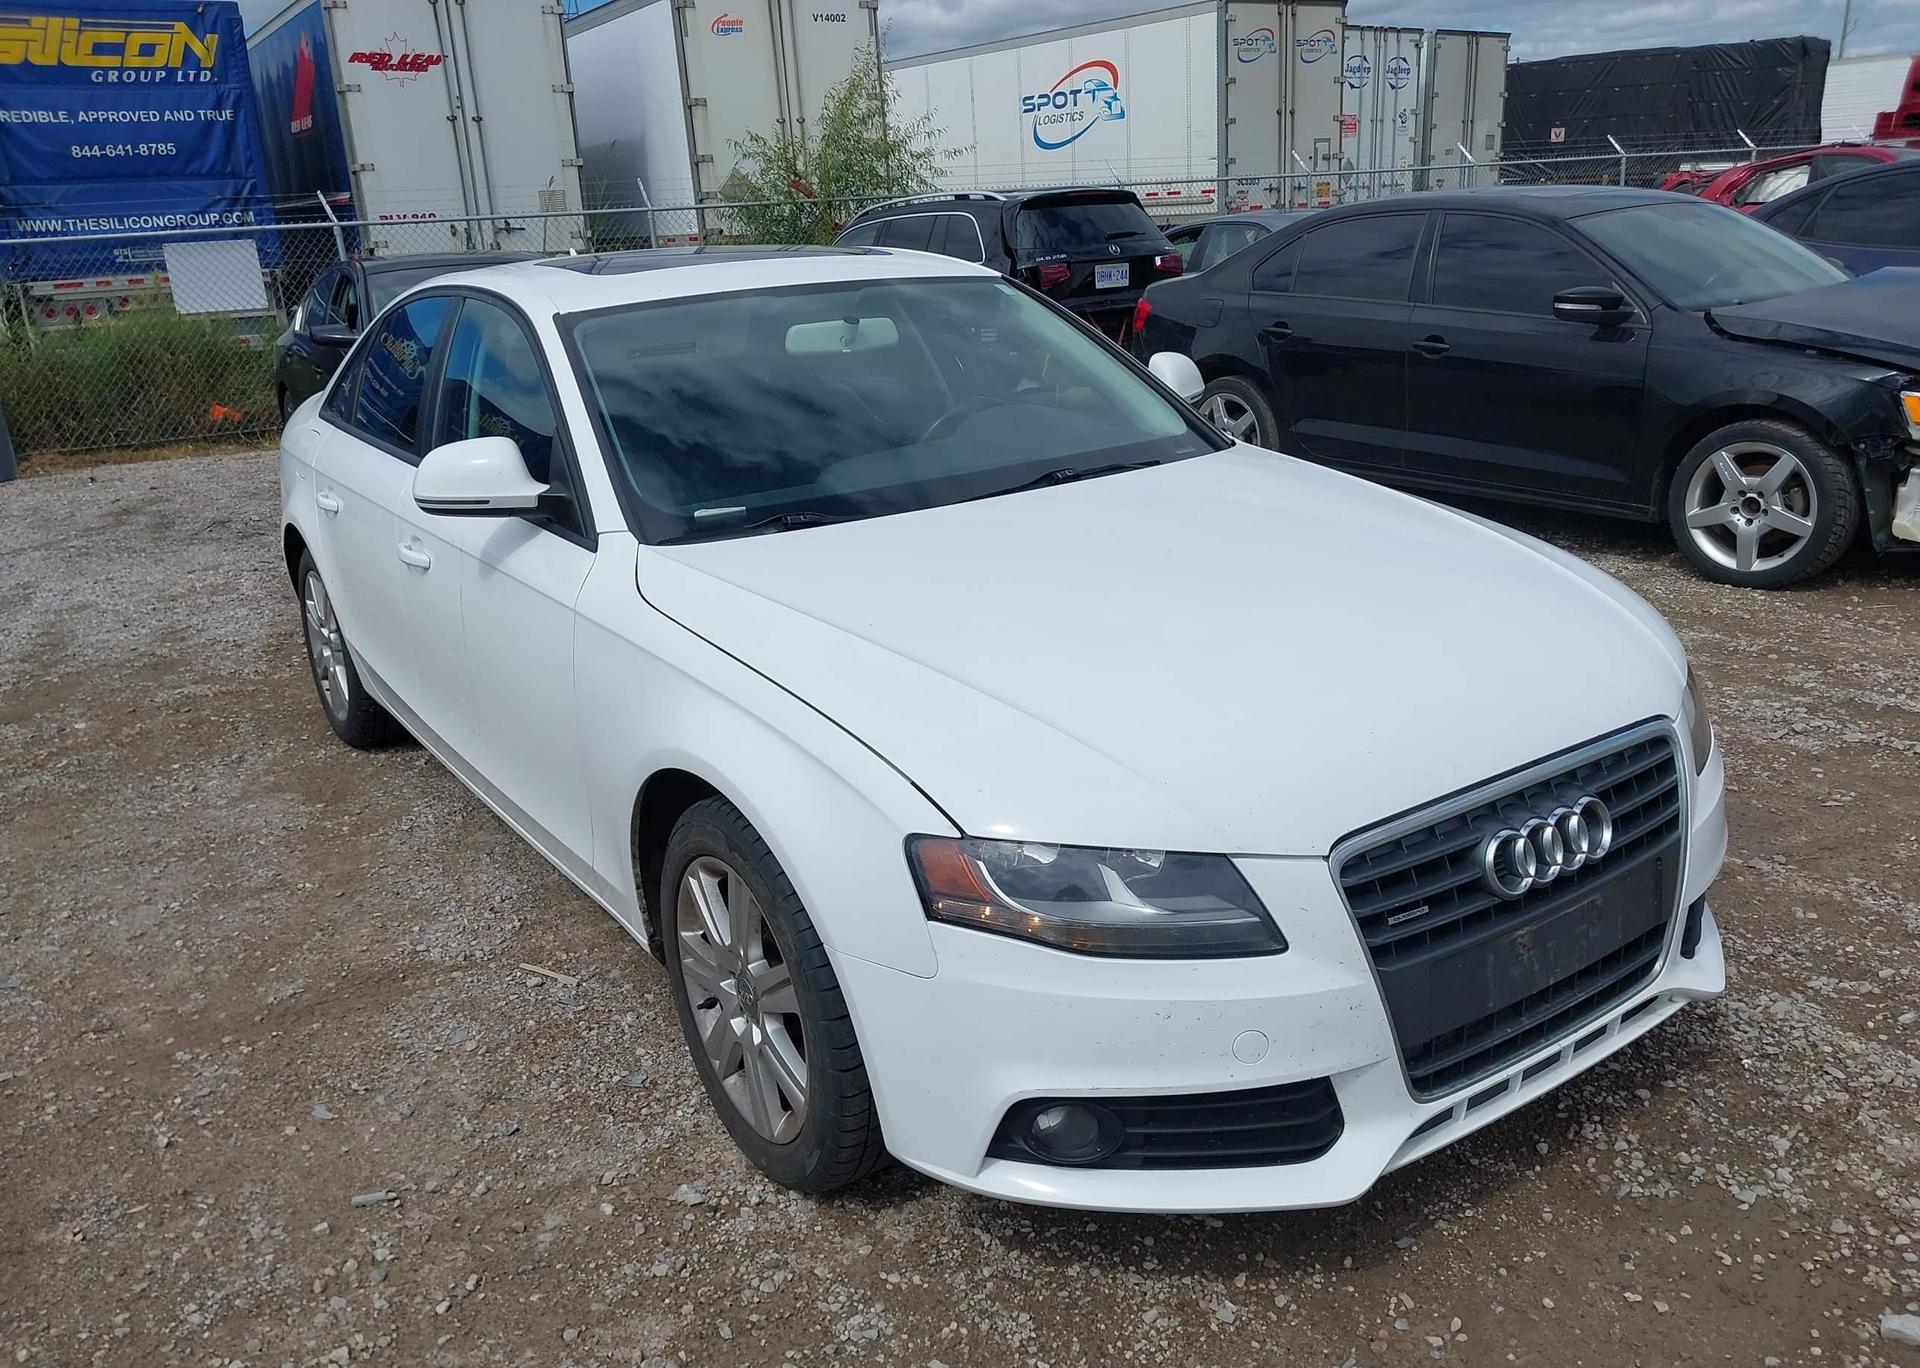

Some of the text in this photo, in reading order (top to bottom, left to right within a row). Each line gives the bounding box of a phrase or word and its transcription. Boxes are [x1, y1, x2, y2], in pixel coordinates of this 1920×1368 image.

[717, 18, 744, 27] People
[812, 12, 847, 24] V14002
[717, 26, 744, 34] Express
[1232, 38, 1260, 47] SPOT
[1296, 39, 1322, 47] SPOT
[348, 52, 393, 63] RED
[1345, 63, 1371, 75] Jagdep
[91, 70, 219, 83] GROUP LTD.
[1022, 88, 1083, 114] SPOT
[78, 110, 160, 123] APPROVED
[163, 110, 195, 122] AND
[197, 109, 235, 122] TRUE
[1038, 111, 1085, 126] LOGISTICS
[71, 143, 176, 158] 844-641-8785
[15, 210, 255, 233] WWW.THESILICONGROUP.COM
[1115, 269, 1128, 281] 244
